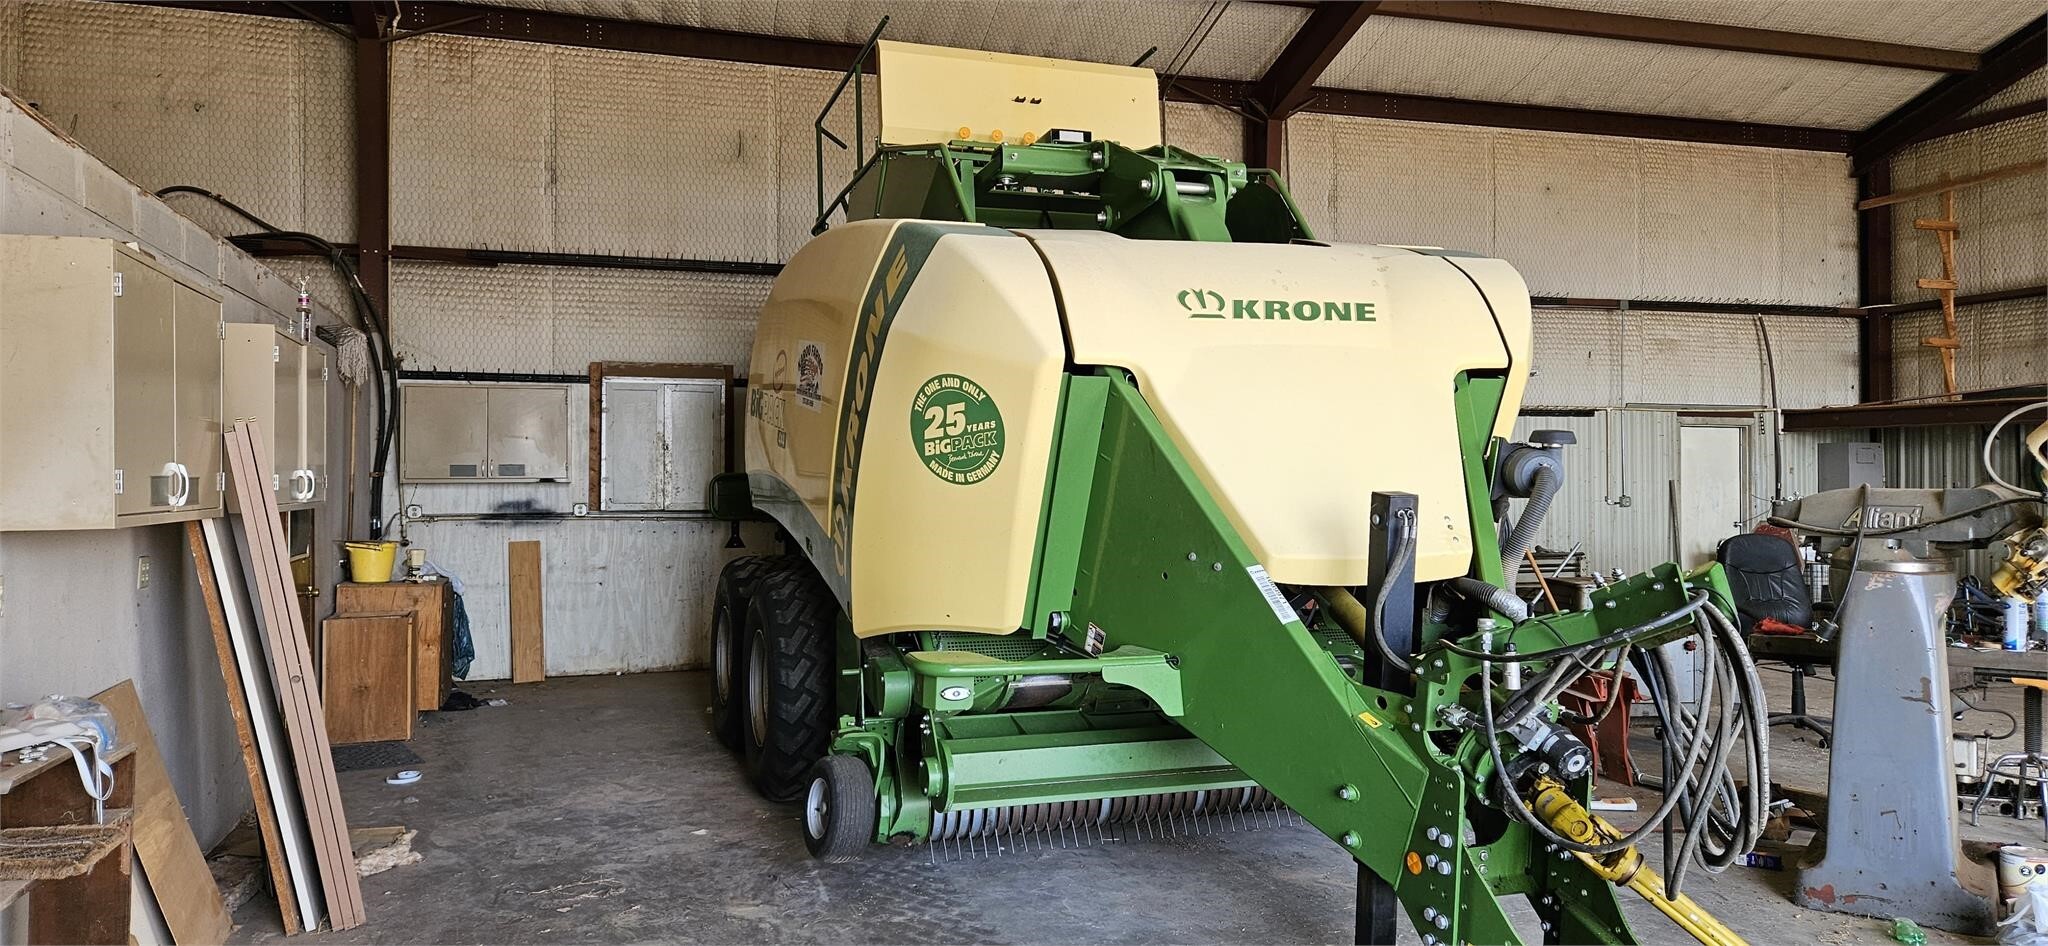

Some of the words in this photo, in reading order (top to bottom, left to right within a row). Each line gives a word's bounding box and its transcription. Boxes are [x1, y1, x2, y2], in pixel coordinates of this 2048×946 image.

[1232, 299, 1377, 322] KRONE
[841, 243, 909, 504] KRONE
[914, 393, 927, 412] THE
[924, 379, 941, 396] ONE
[942, 377, 960, 388] AND
[962, 381, 987, 401] ONLY
[924, 402, 966, 440] 25
[966, 420, 996, 433] YEARS
[929, 460, 954, 480] MADE
[955, 473, 965, 482] IN
[966, 450, 1000, 482] GERMANY
[1842, 504, 1923, 529] Alliant
